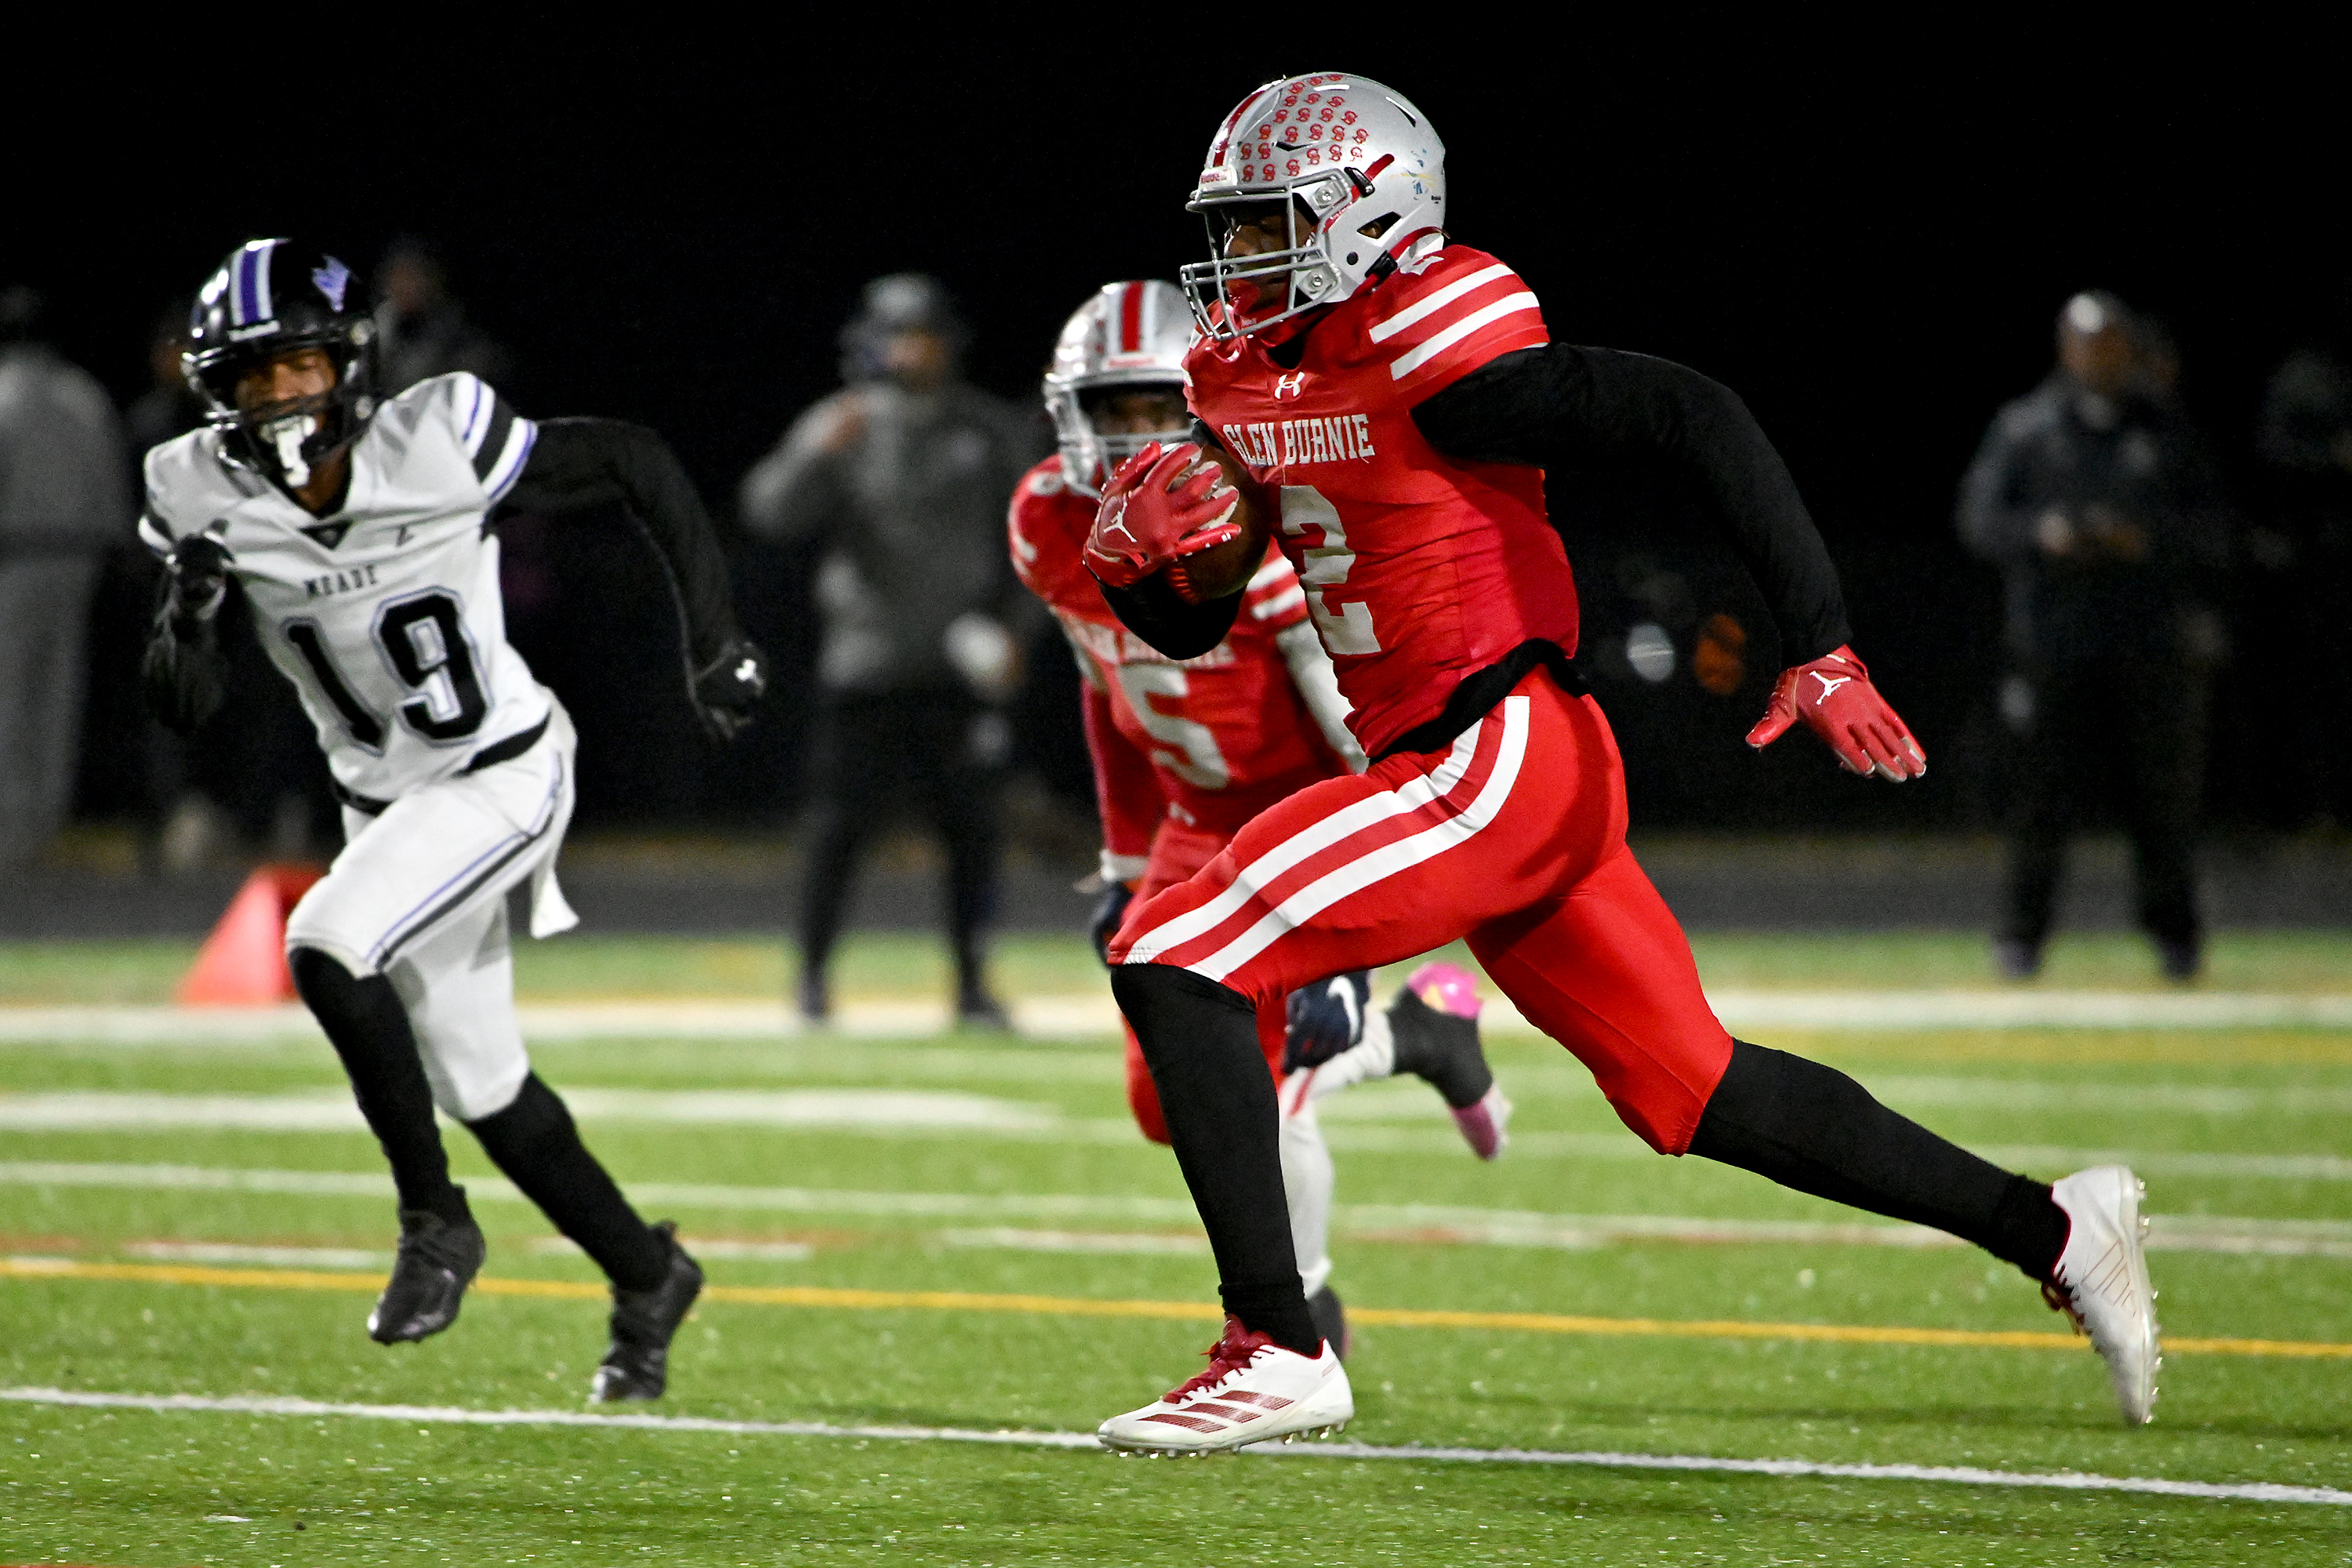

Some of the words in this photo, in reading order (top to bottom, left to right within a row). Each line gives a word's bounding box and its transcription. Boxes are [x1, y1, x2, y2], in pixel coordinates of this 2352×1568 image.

[1223, 422, 1278, 466] GLEN
[1282, 413, 1375, 466] BURNIE
[1279, 485, 1381, 655] 2
[281, 586, 494, 757] 19
[1116, 665, 1232, 789] 5
